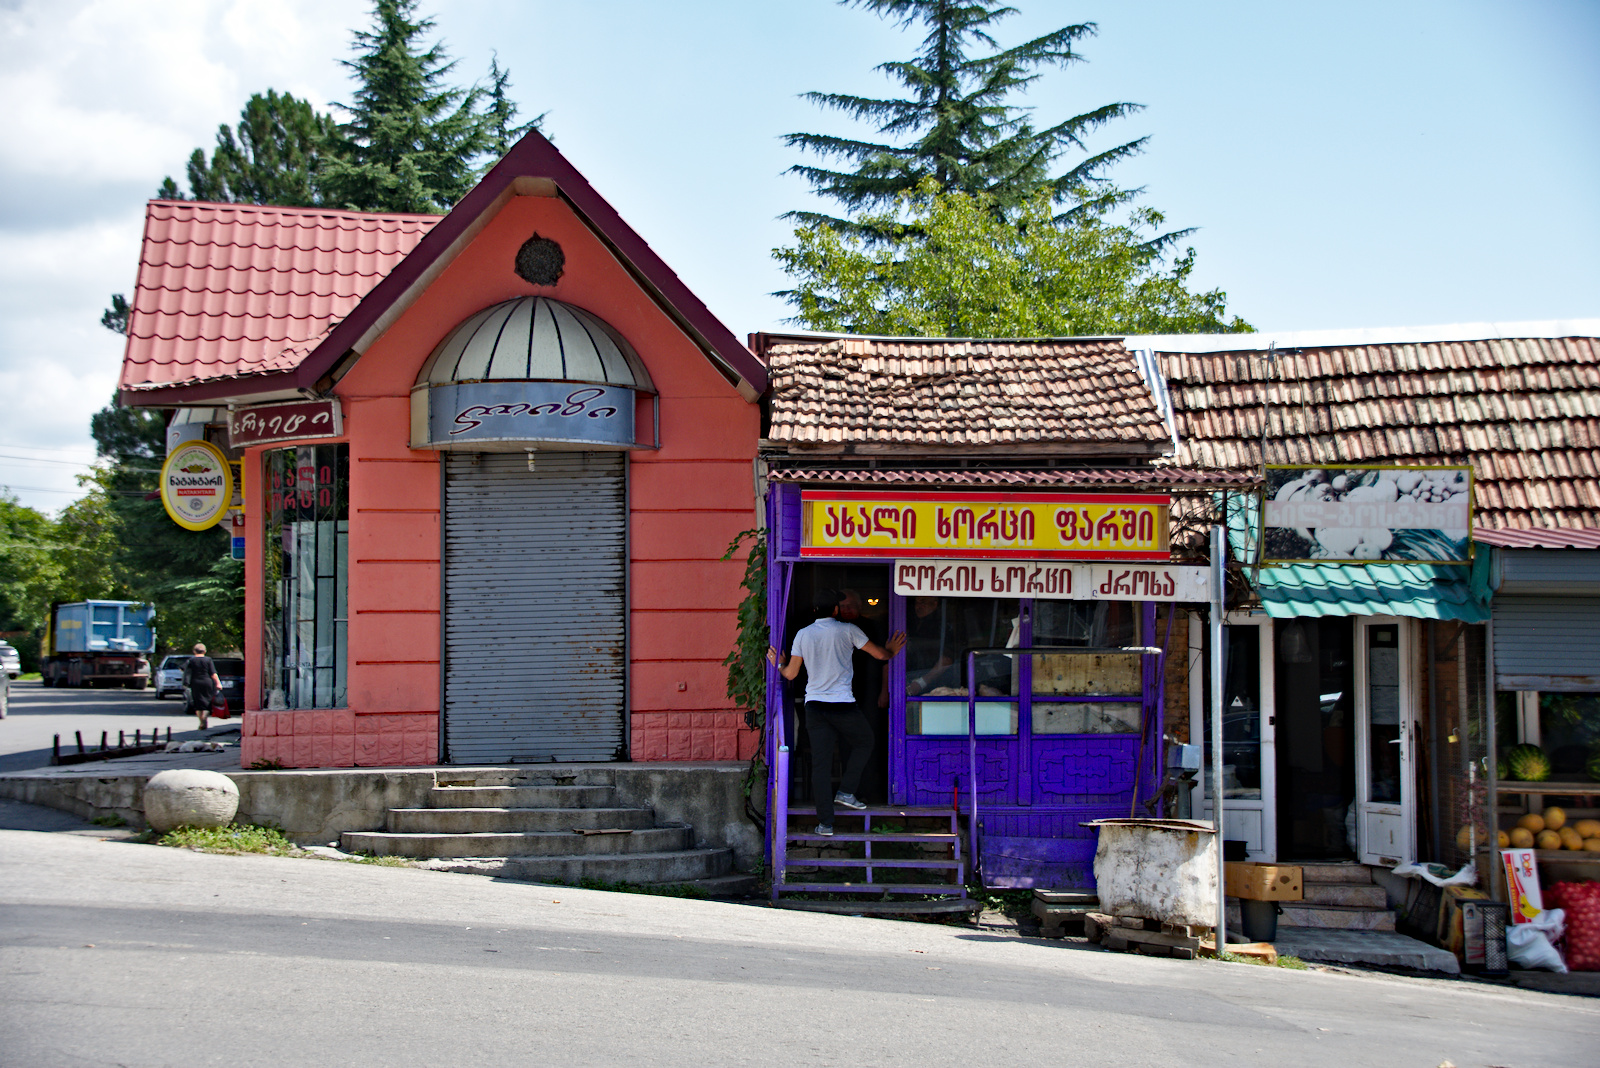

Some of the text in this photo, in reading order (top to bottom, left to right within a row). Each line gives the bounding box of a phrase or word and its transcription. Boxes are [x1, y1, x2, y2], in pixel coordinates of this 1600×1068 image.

[169, 475, 223, 486] ნატახტარი
[823, 505, 1154, 546] ახალი ხორცი ფარში
[1266, 502, 1464, 529] ხილ-ბოსტანი
[898, 565, 1072, 594] ღორის ხორცი
[1100, 569, 1175, 597] ძროხა
[1522, 853, 1533, 877] Dole
